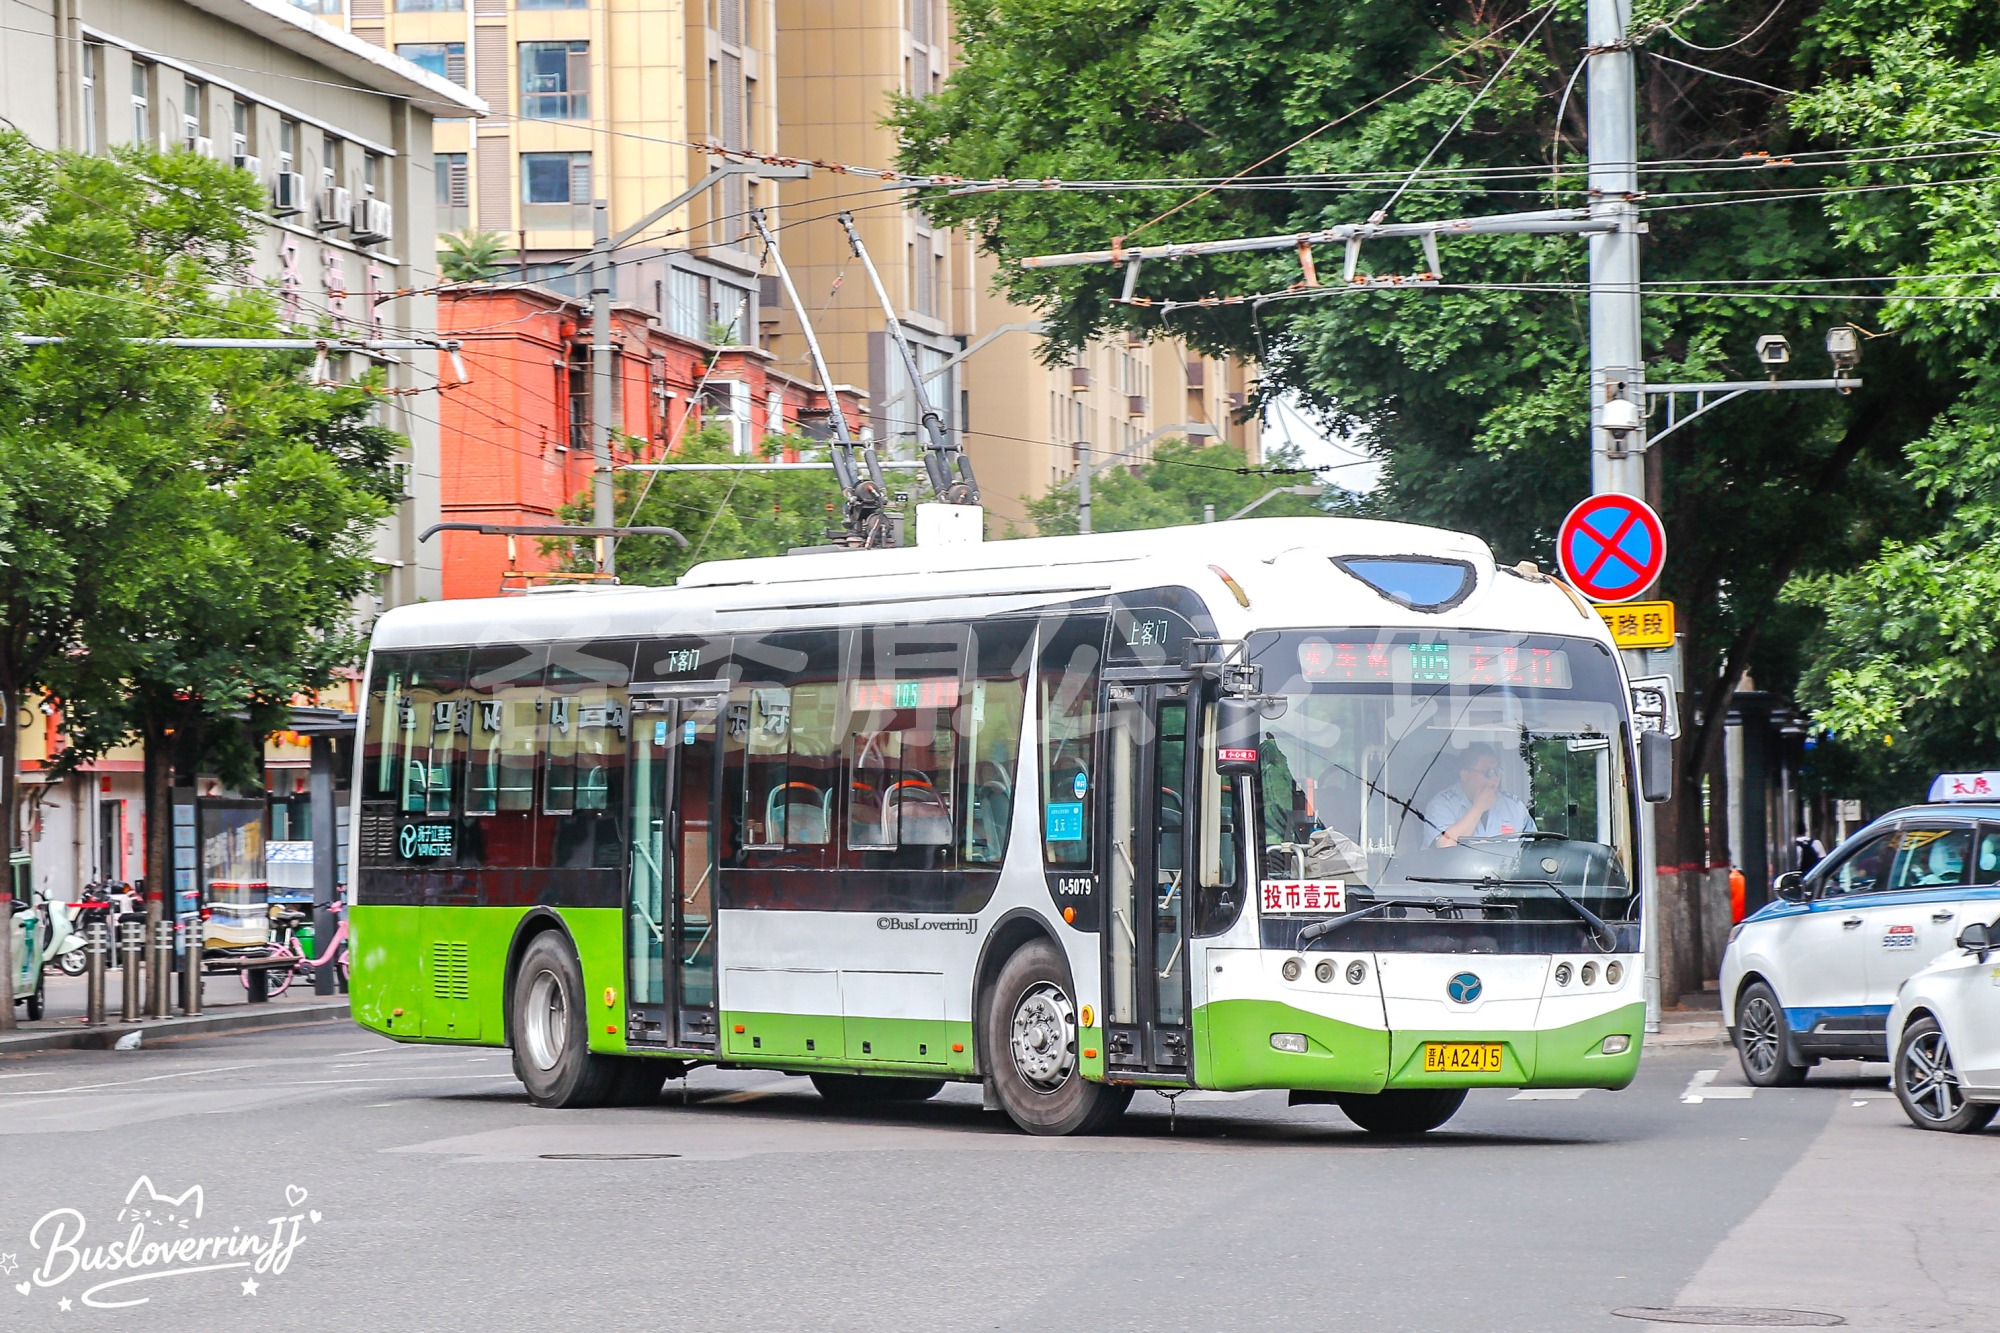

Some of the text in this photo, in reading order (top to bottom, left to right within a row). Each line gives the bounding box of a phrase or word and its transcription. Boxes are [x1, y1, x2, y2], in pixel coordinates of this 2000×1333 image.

[1126, 619, 1168, 648] 上客门
[668, 648, 700, 673] 下客门
[895, 682, 919, 707] 105
[1951, 777, 1992, 795] 太原
[1264, 884, 1341, 910] 投币壹元
